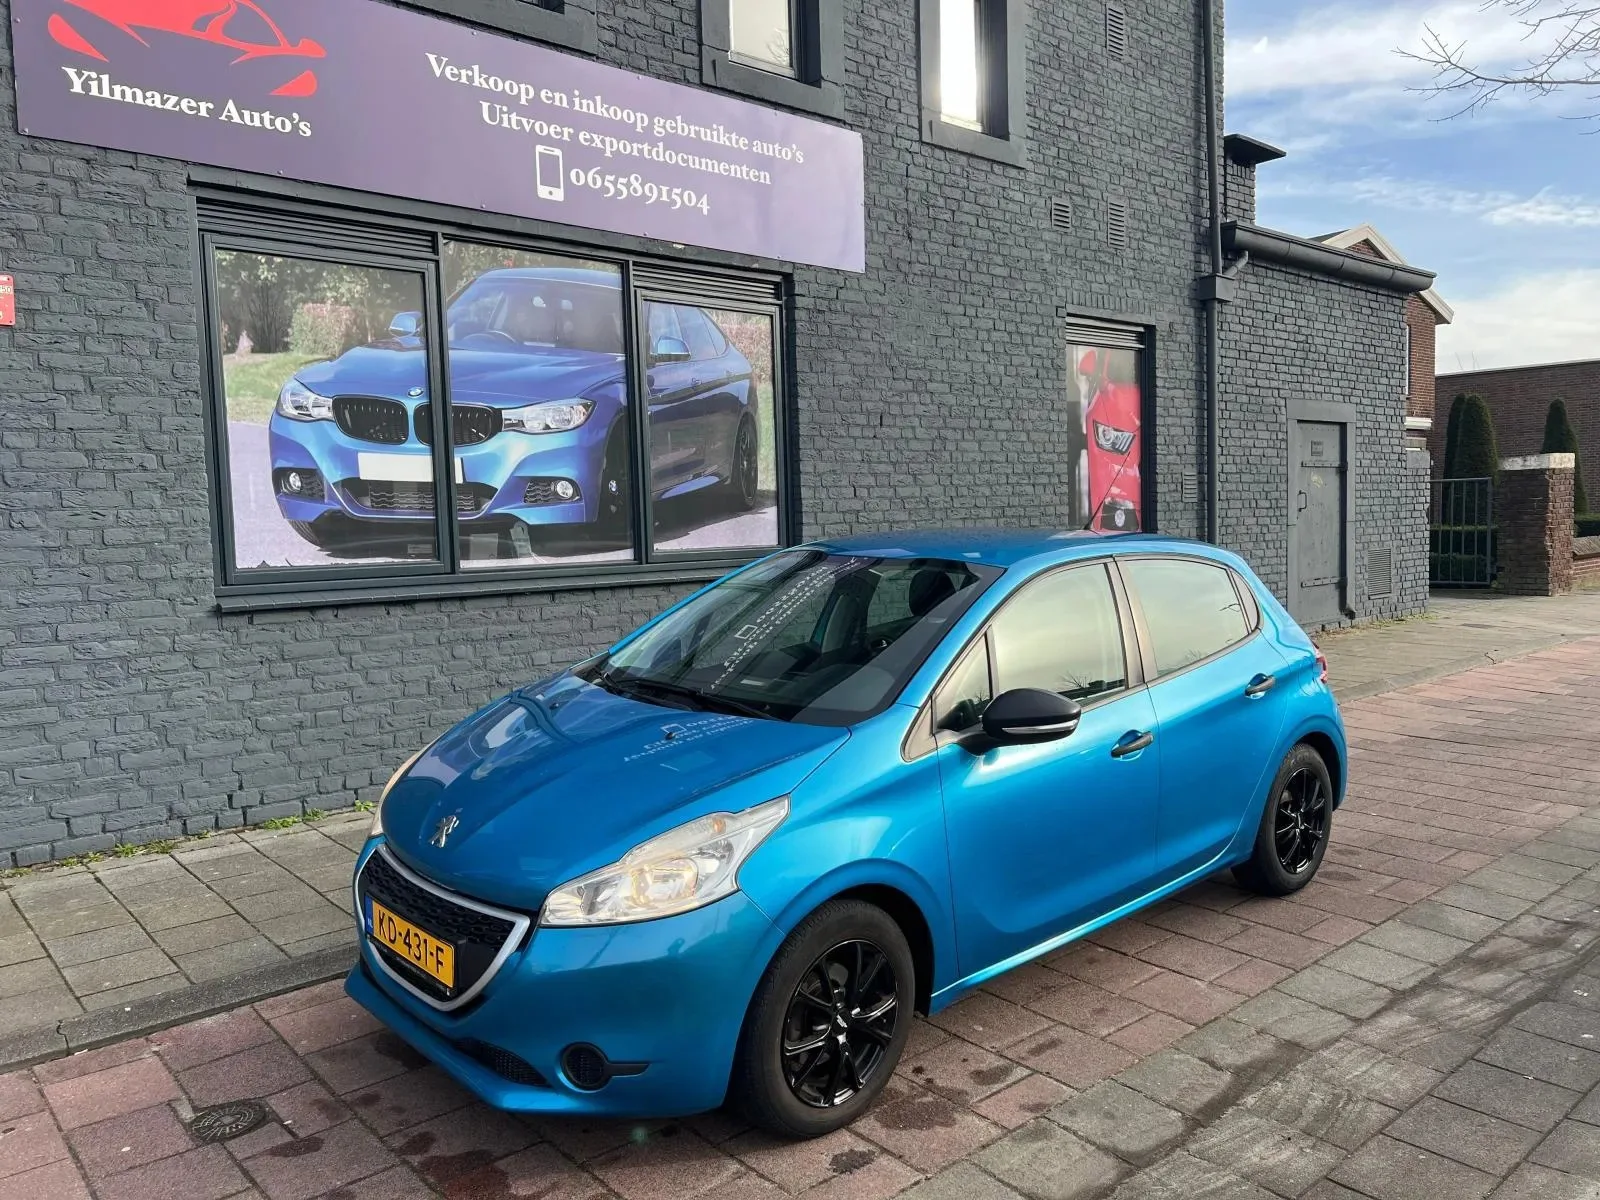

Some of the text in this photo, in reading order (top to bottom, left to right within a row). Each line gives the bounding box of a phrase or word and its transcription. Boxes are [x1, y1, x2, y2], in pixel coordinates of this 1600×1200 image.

[62, 66, 312, 137] Yilmazer Auto's
[424, 52, 805, 164] Verkoop en inkoop gebruikte auto's
[479, 100, 771, 185] Uitvoer exportdocumenten
[569, 167, 711, 217] 0655891504
[378, 909, 445, 974] KD-431-F
